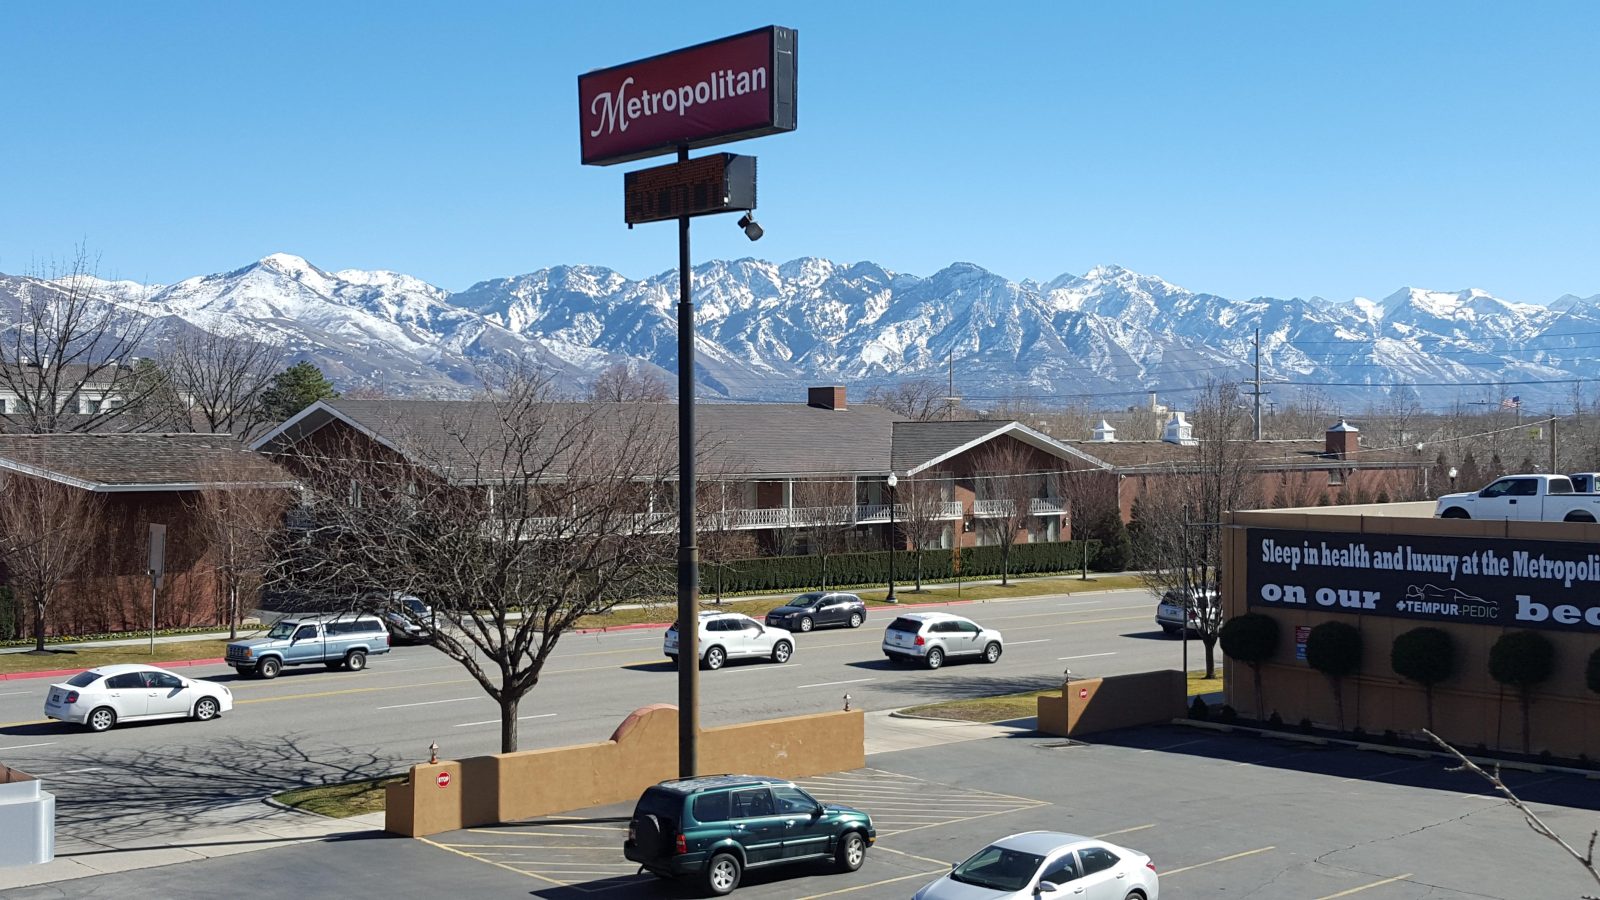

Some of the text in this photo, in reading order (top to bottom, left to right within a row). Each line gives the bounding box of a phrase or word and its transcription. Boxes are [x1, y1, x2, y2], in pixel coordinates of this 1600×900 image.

[590, 66, 767, 138] Metropolitan
[1261, 538, 1600, 588] Sleep in health and luxury at the Metropoli
[1260, 583, 1307, 604] on
[1315, 587, 1381, 610] our
[1405, 600, 1498, 618] TEMPUR-PEDIC
